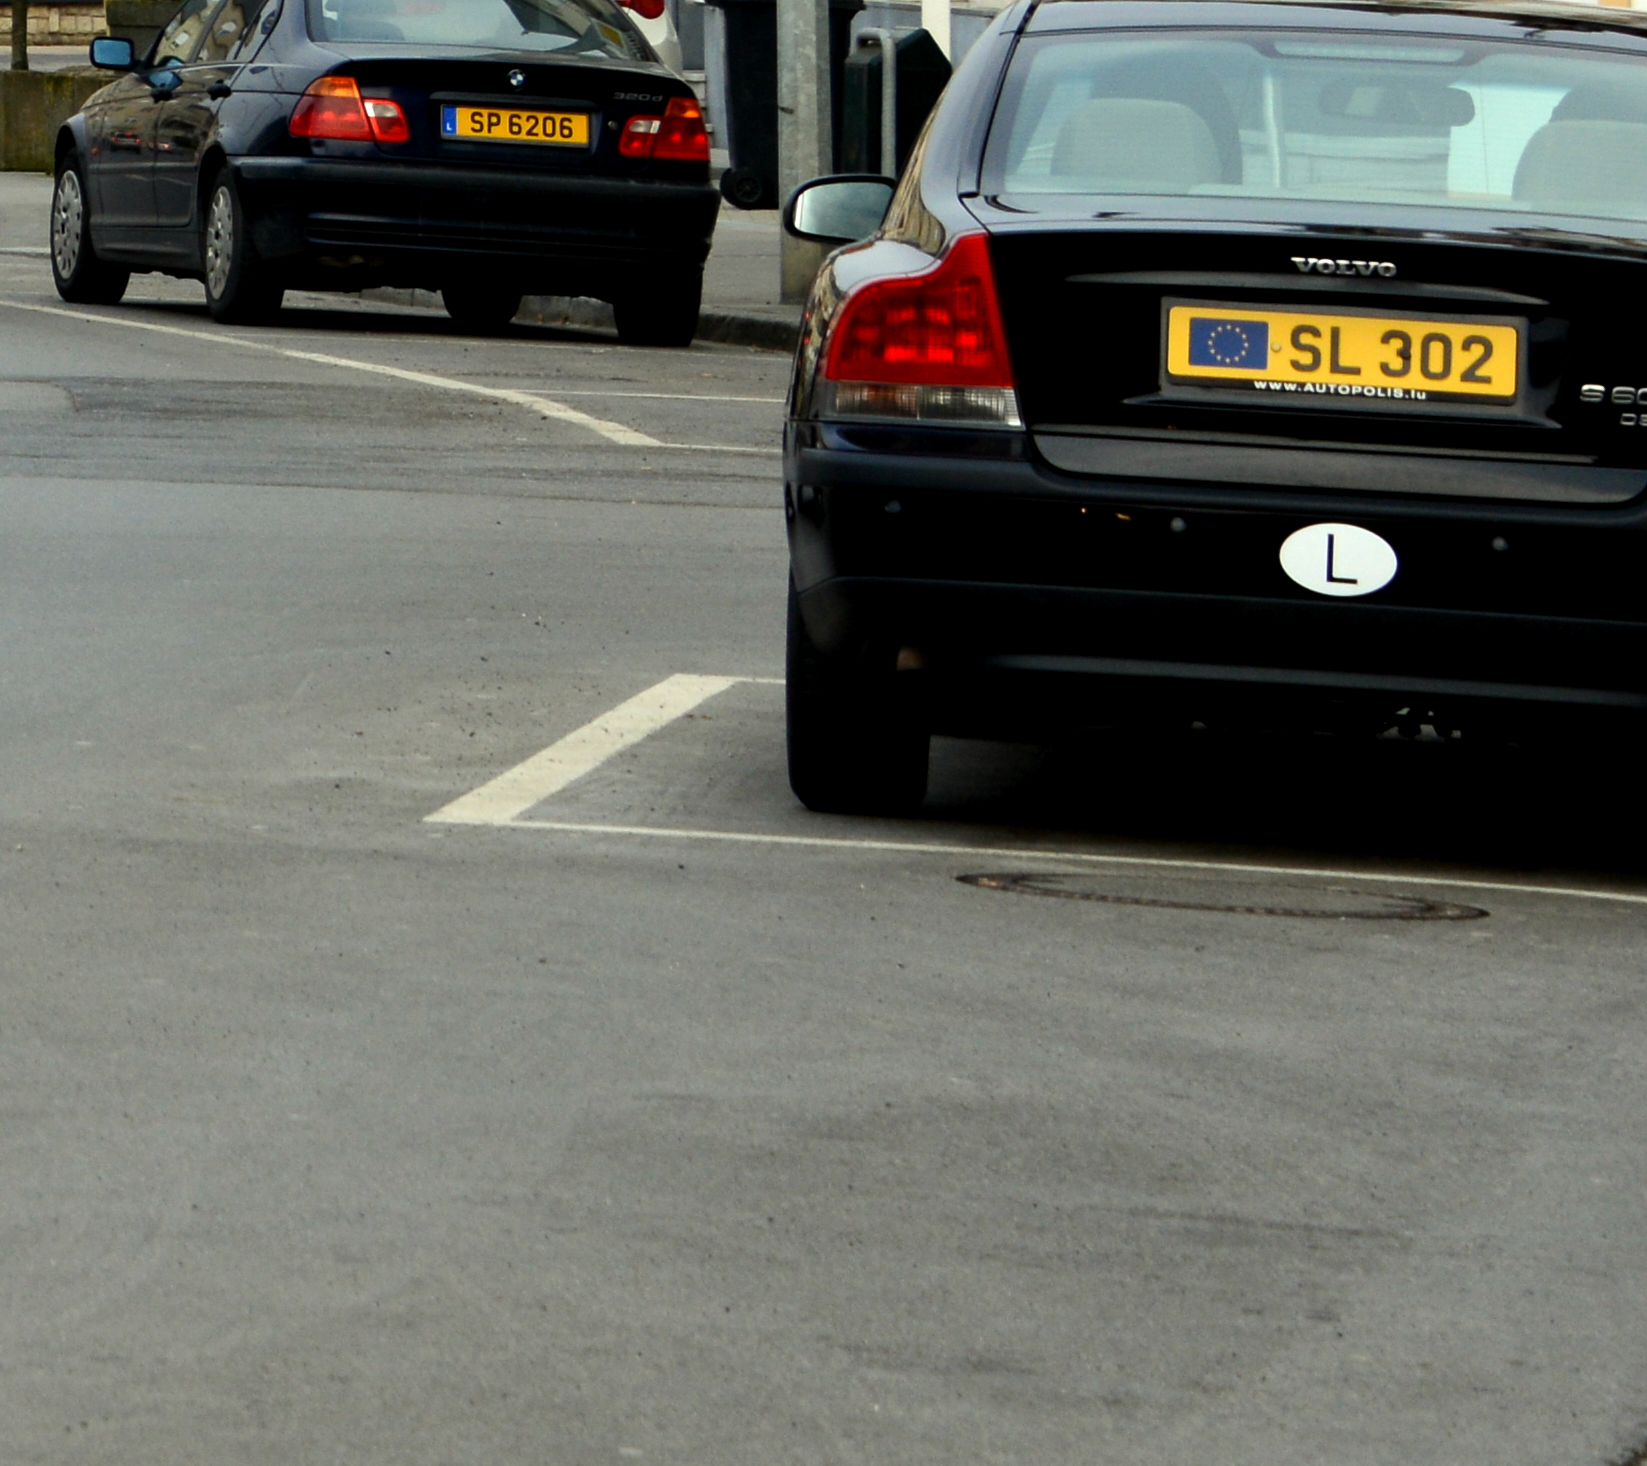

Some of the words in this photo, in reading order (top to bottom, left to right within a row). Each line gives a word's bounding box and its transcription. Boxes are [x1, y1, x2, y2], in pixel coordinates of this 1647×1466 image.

[469, 111, 501, 135] SP
[508, 114, 574, 139] 6206
[1290, 256, 1398, 278] VOLVO
[1289, 324, 1361, 376] SL
[1379, 330, 1494, 385] 302
[1253, 380, 1427, 401] www.AUTOPOLIS.lu
[1325, 533, 1359, 585] L
